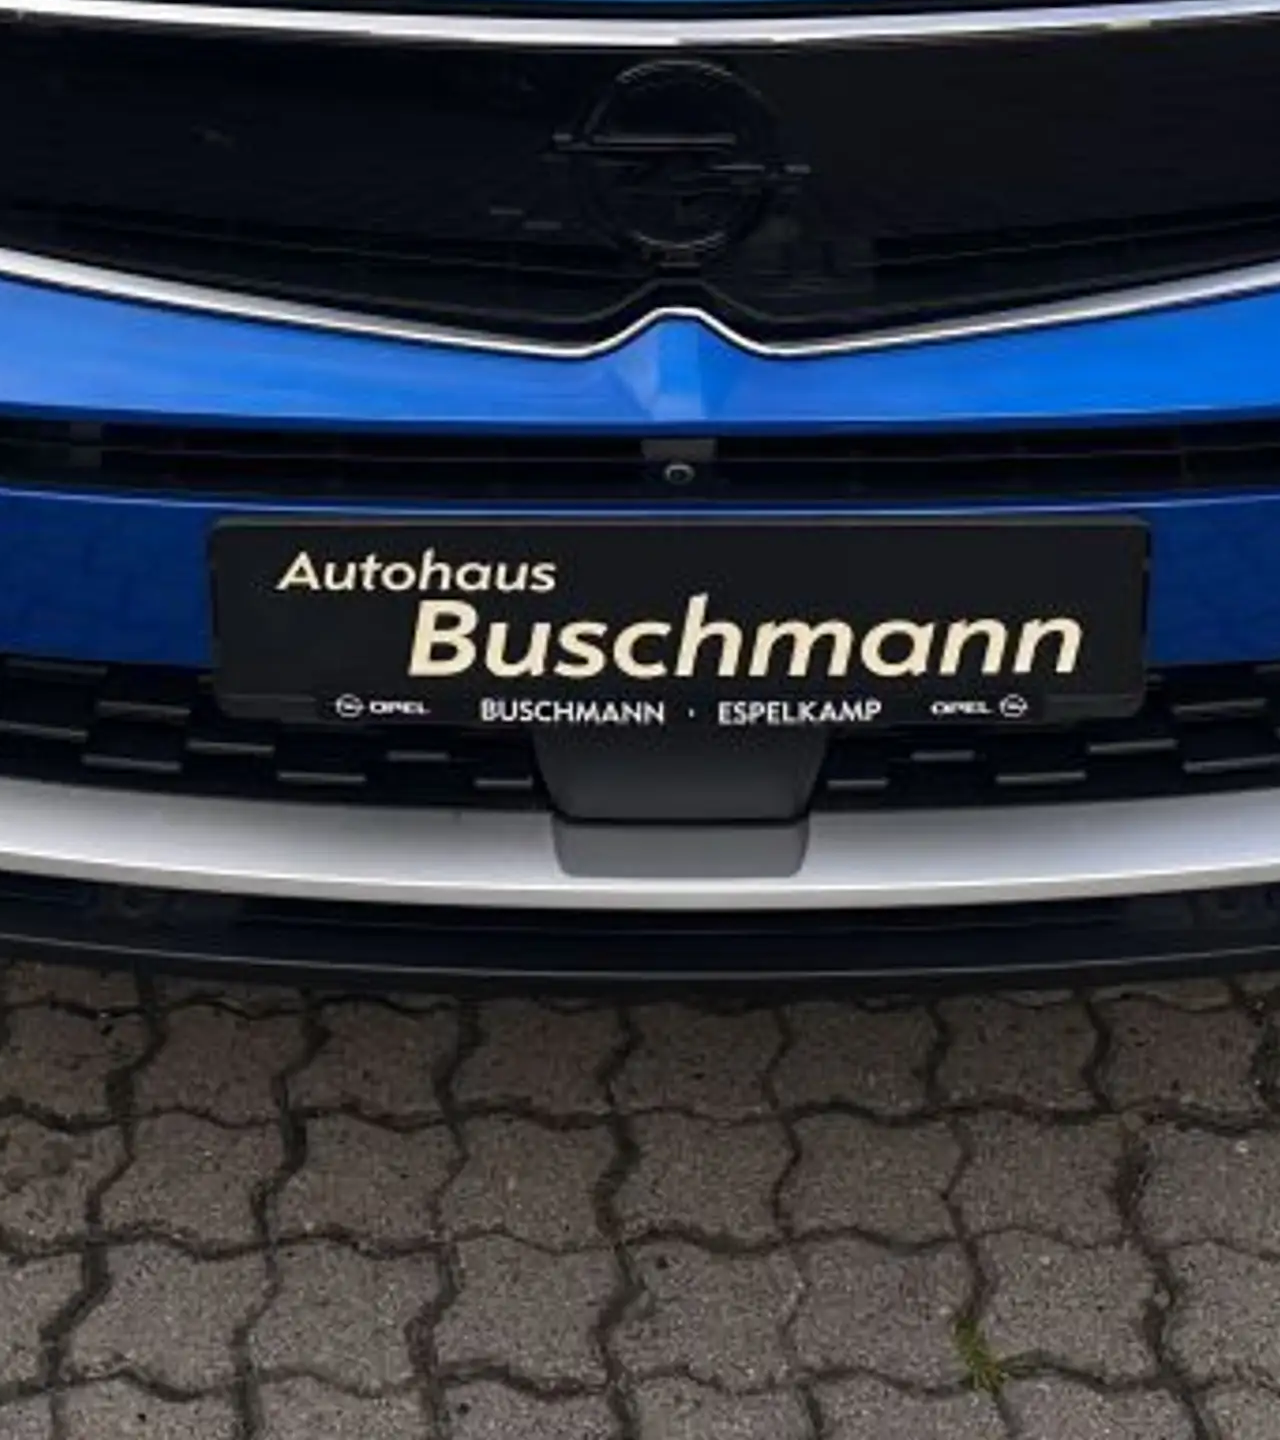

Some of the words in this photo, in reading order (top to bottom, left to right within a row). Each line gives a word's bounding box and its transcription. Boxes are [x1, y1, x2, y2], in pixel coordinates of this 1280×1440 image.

[275, 546, 557, 593] Autohaus
[407, 592, 1083, 679] Buschmann
[368, 699, 431, 716] OPEL
[479, 696, 666, 724] BUSCHMANN
[717, 697, 883, 726] ESPELKAMP
[930, 700, 993, 716] OPEL
